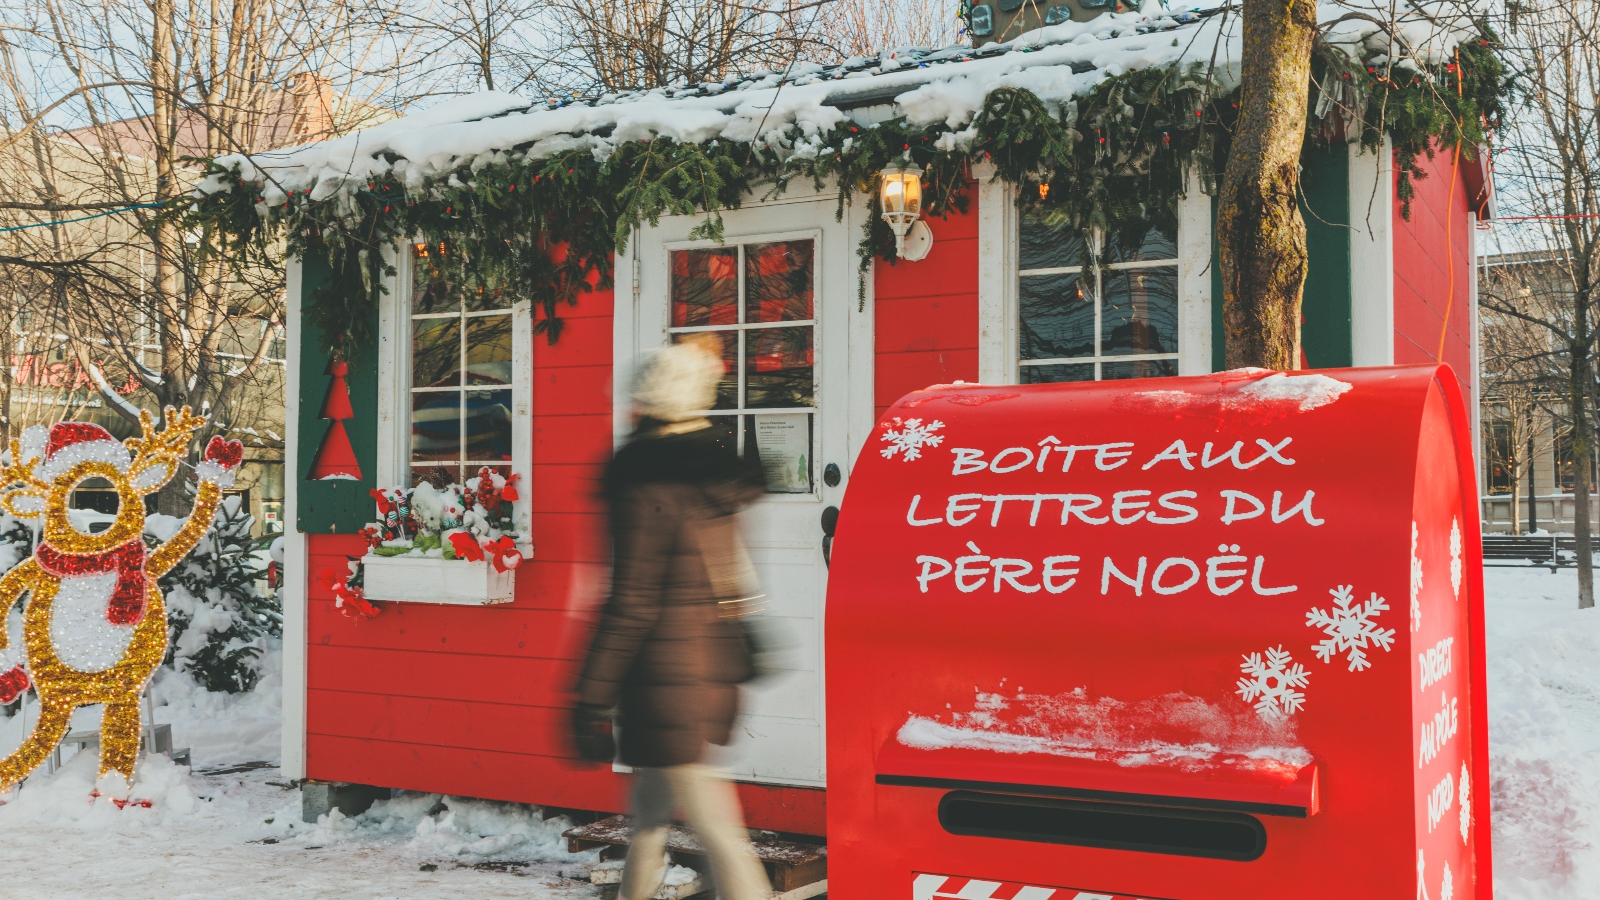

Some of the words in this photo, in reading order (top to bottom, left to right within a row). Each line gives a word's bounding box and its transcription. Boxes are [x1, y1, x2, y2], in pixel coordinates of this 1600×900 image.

[950, 434, 1135, 476] BOÎTE
[1141, 436, 1296, 471] AUX
[906, 489, 1199, 528] LETTRES
[1219, 489, 1325, 527] DU
[915, 540, 1081, 595] PÈRE
[1100, 543, 1298, 597] NOËL
[1418, 636, 1454, 693] DIRECT
[1418, 720, 1437, 770] AU
[1434, 690, 1458, 752] PÔLE
[1427, 772, 1454, 834] NORD
